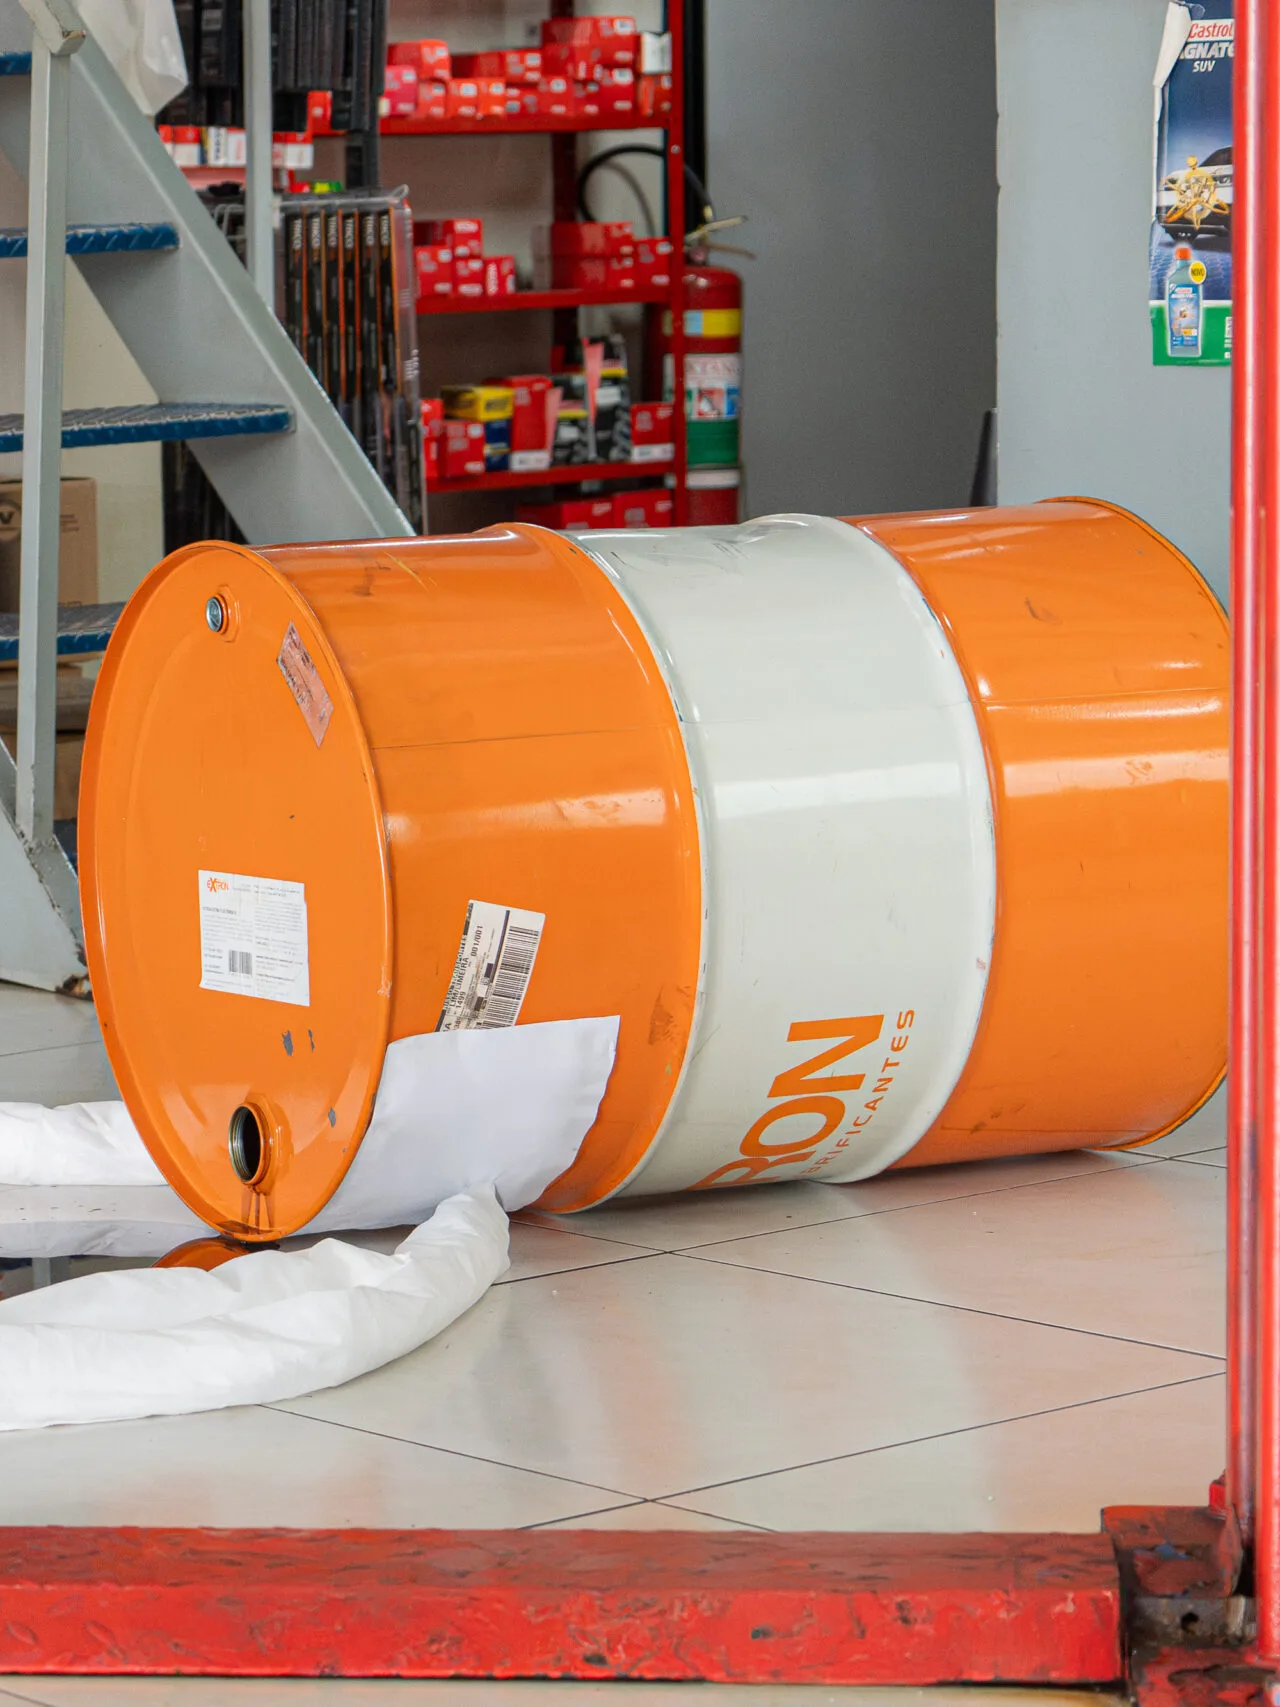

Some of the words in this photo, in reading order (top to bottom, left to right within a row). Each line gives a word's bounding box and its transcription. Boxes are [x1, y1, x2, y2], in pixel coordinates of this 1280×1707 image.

[1192, 60, 1216, 73] SUV
[450, 957, 468, 1007] LIM/LIMEIRA
[456, 991, 466, 1008] 1499
